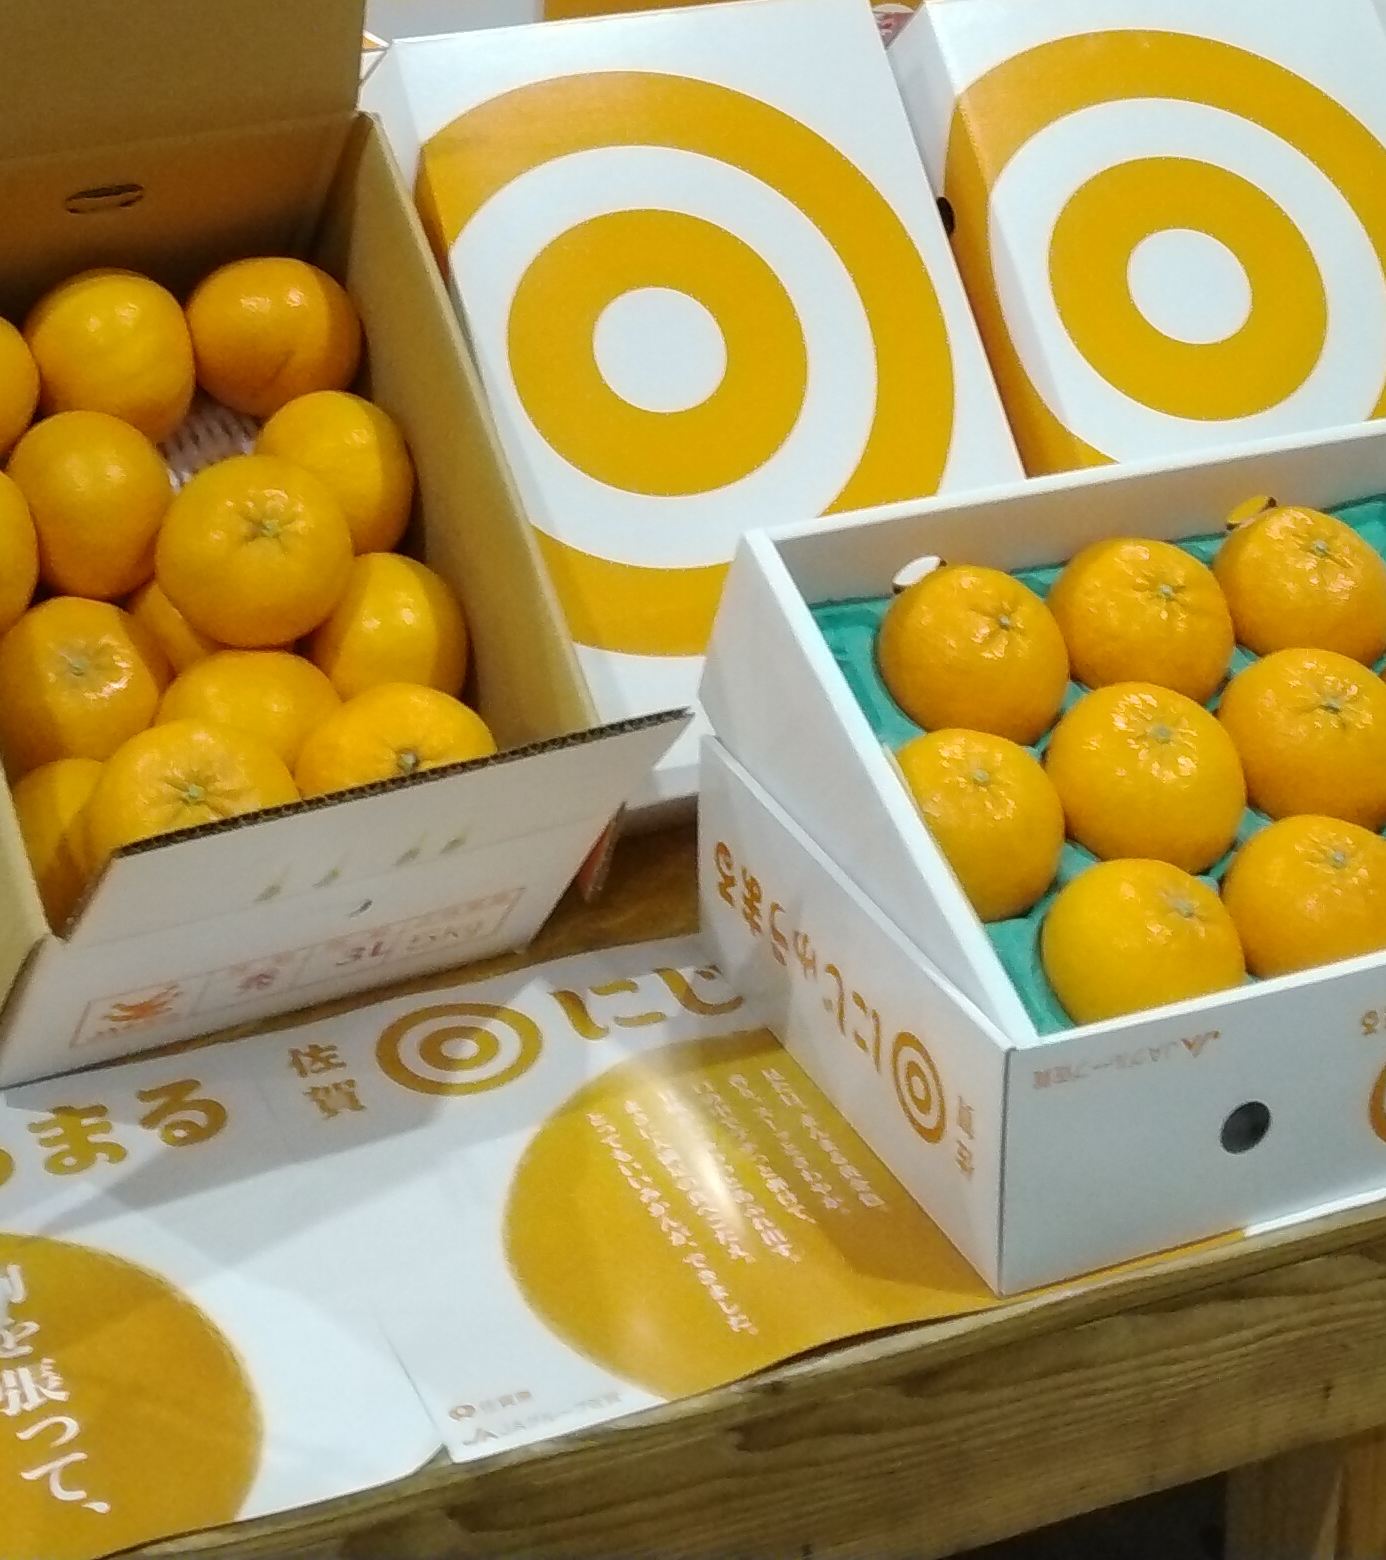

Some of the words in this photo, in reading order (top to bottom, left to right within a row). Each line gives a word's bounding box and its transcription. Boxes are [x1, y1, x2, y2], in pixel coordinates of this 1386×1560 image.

[715, 842, 882, 1074] にじゅうまる
[289, 1043, 366, 1119] 佐賀
